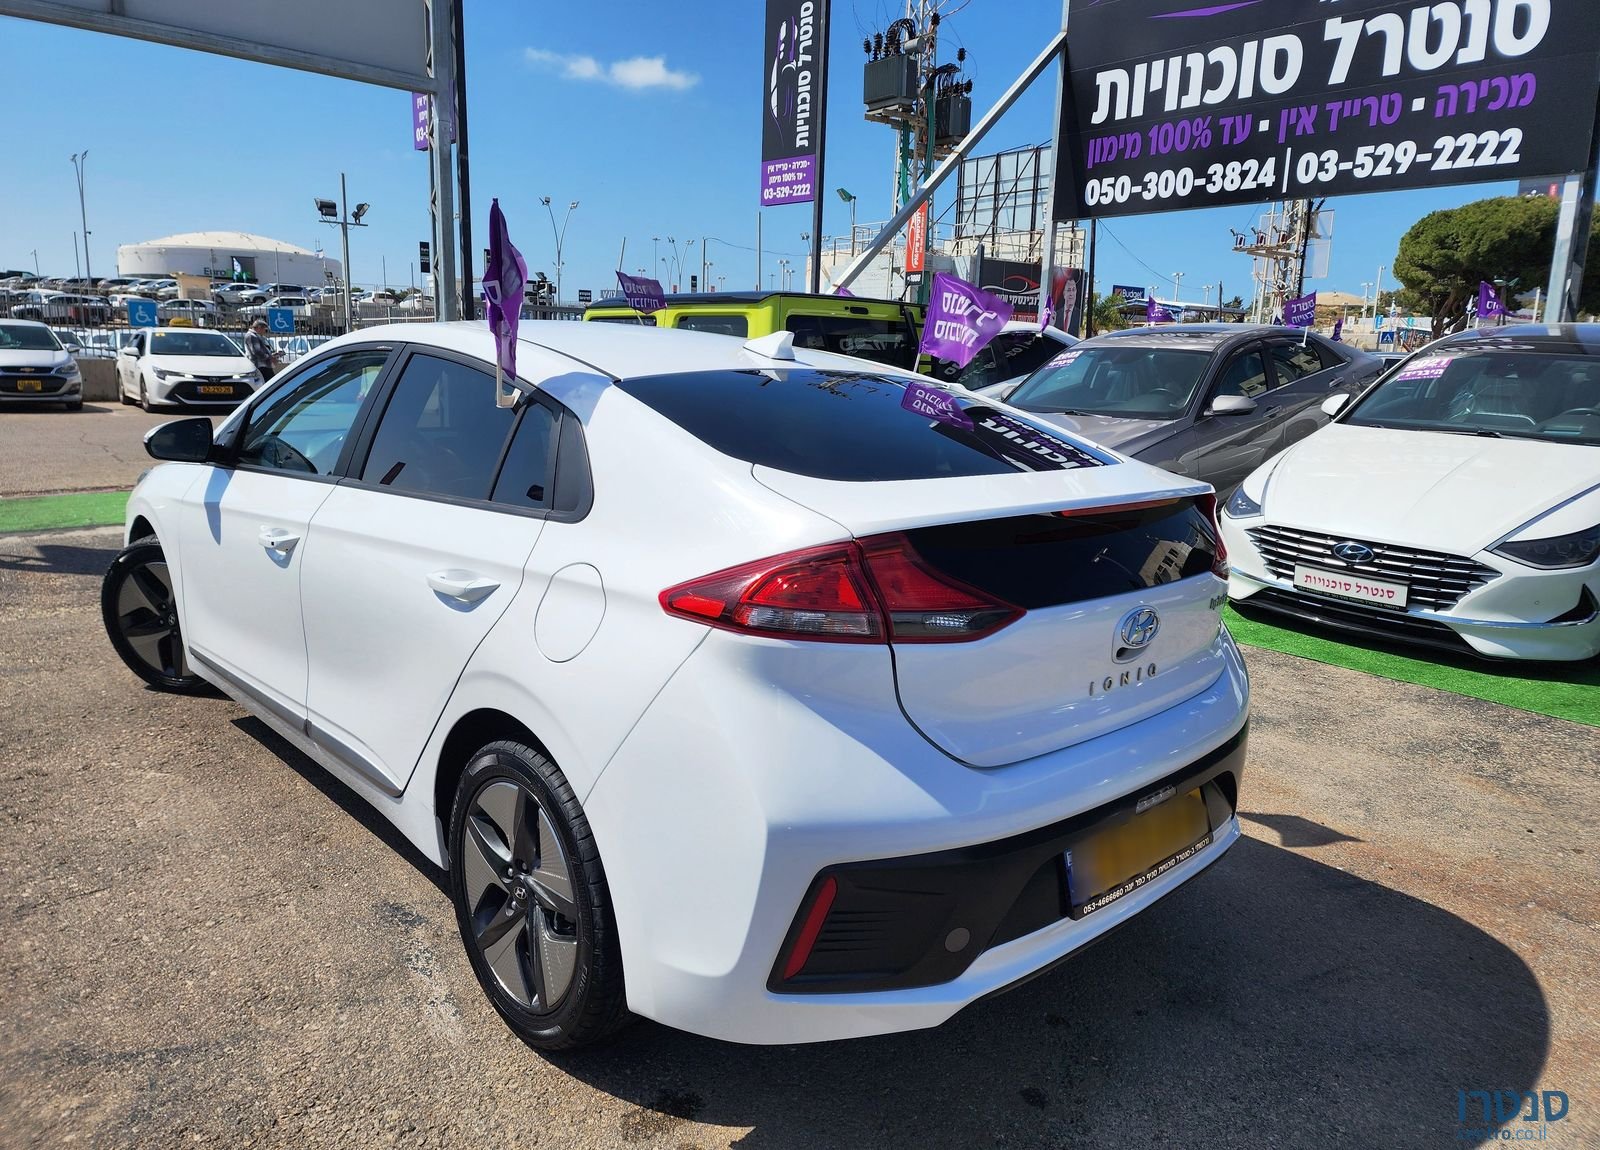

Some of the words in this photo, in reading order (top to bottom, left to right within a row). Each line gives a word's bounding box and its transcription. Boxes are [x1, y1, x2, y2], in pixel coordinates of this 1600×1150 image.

[797, 1, 814, 67] סנטרל
[1323, 0, 1551, 86] סנטרל
[1090, 33, 1304, 125] סוכנויות
[1434, 72, 1537, 118] מכירה
[795, 70, 812, 149] סוכנויות
[1219, 113, 1253, 146] עד
[1277, 104, 1318, 144] אין
[1325, 92, 1403, 133] טרייד
[1086, 131, 1142, 169] מימון
[1148, 116, 1213, 156] 100%
[782, 173, 796, 183] 100%
[1084, 157, 1277, 208] 050-300-3824
[1296, 127, 1524, 185] 03-529-2222
[763, 183, 811, 200] 03-529-2222
[1304, 574, 1352, 592] סוכנויות
[1355, 582, 1396, 599] סנטרל
[1088, 662, 1158, 696] IONIQ
